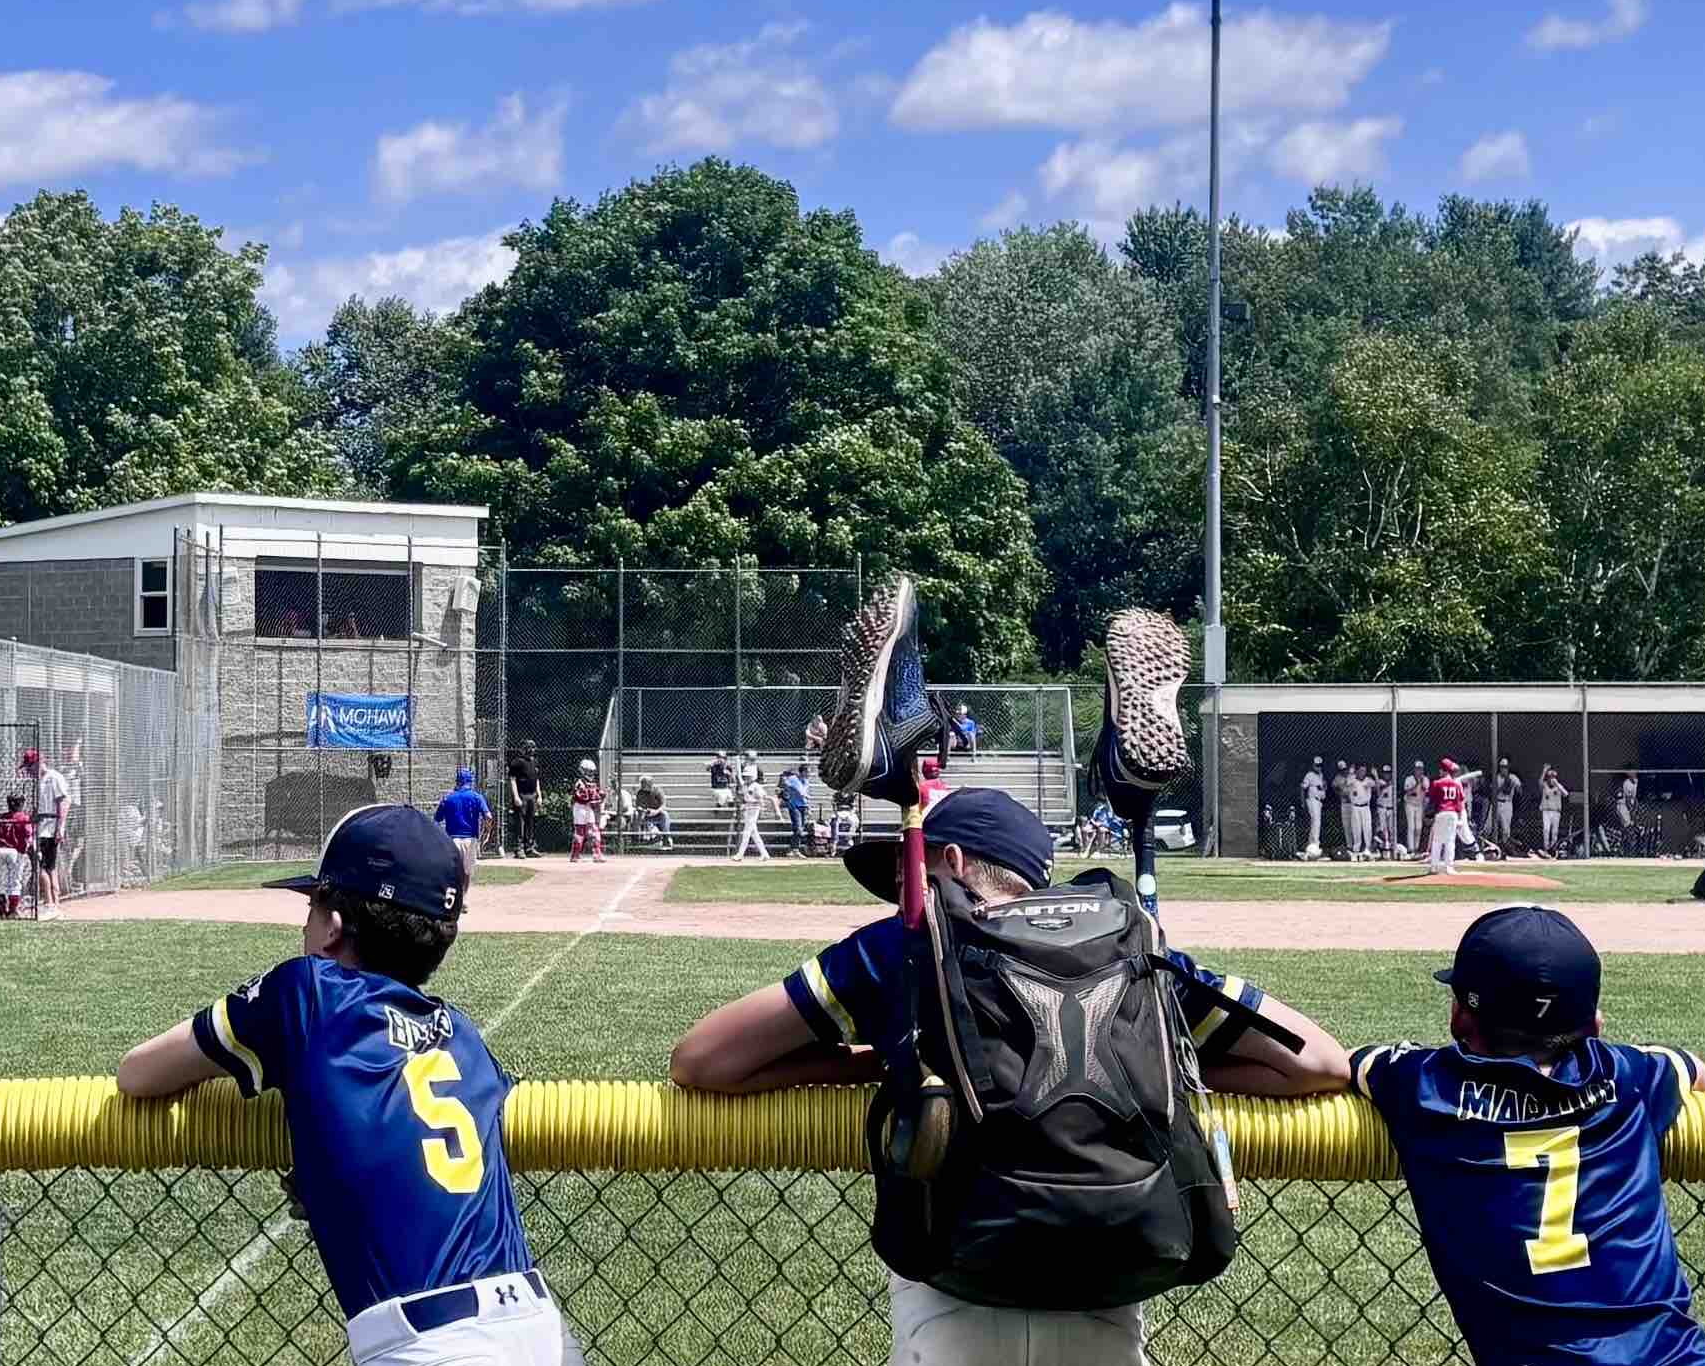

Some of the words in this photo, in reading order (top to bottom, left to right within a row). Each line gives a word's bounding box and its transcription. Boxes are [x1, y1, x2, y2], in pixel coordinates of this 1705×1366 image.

[1443, 786, 1457, 800] 10
[443, 887, 457, 910] 5
[1536, 997, 1553, 1019] 7
[403, 1048, 484, 1194] 5
[1502, 1125, 1592, 1276] 7
